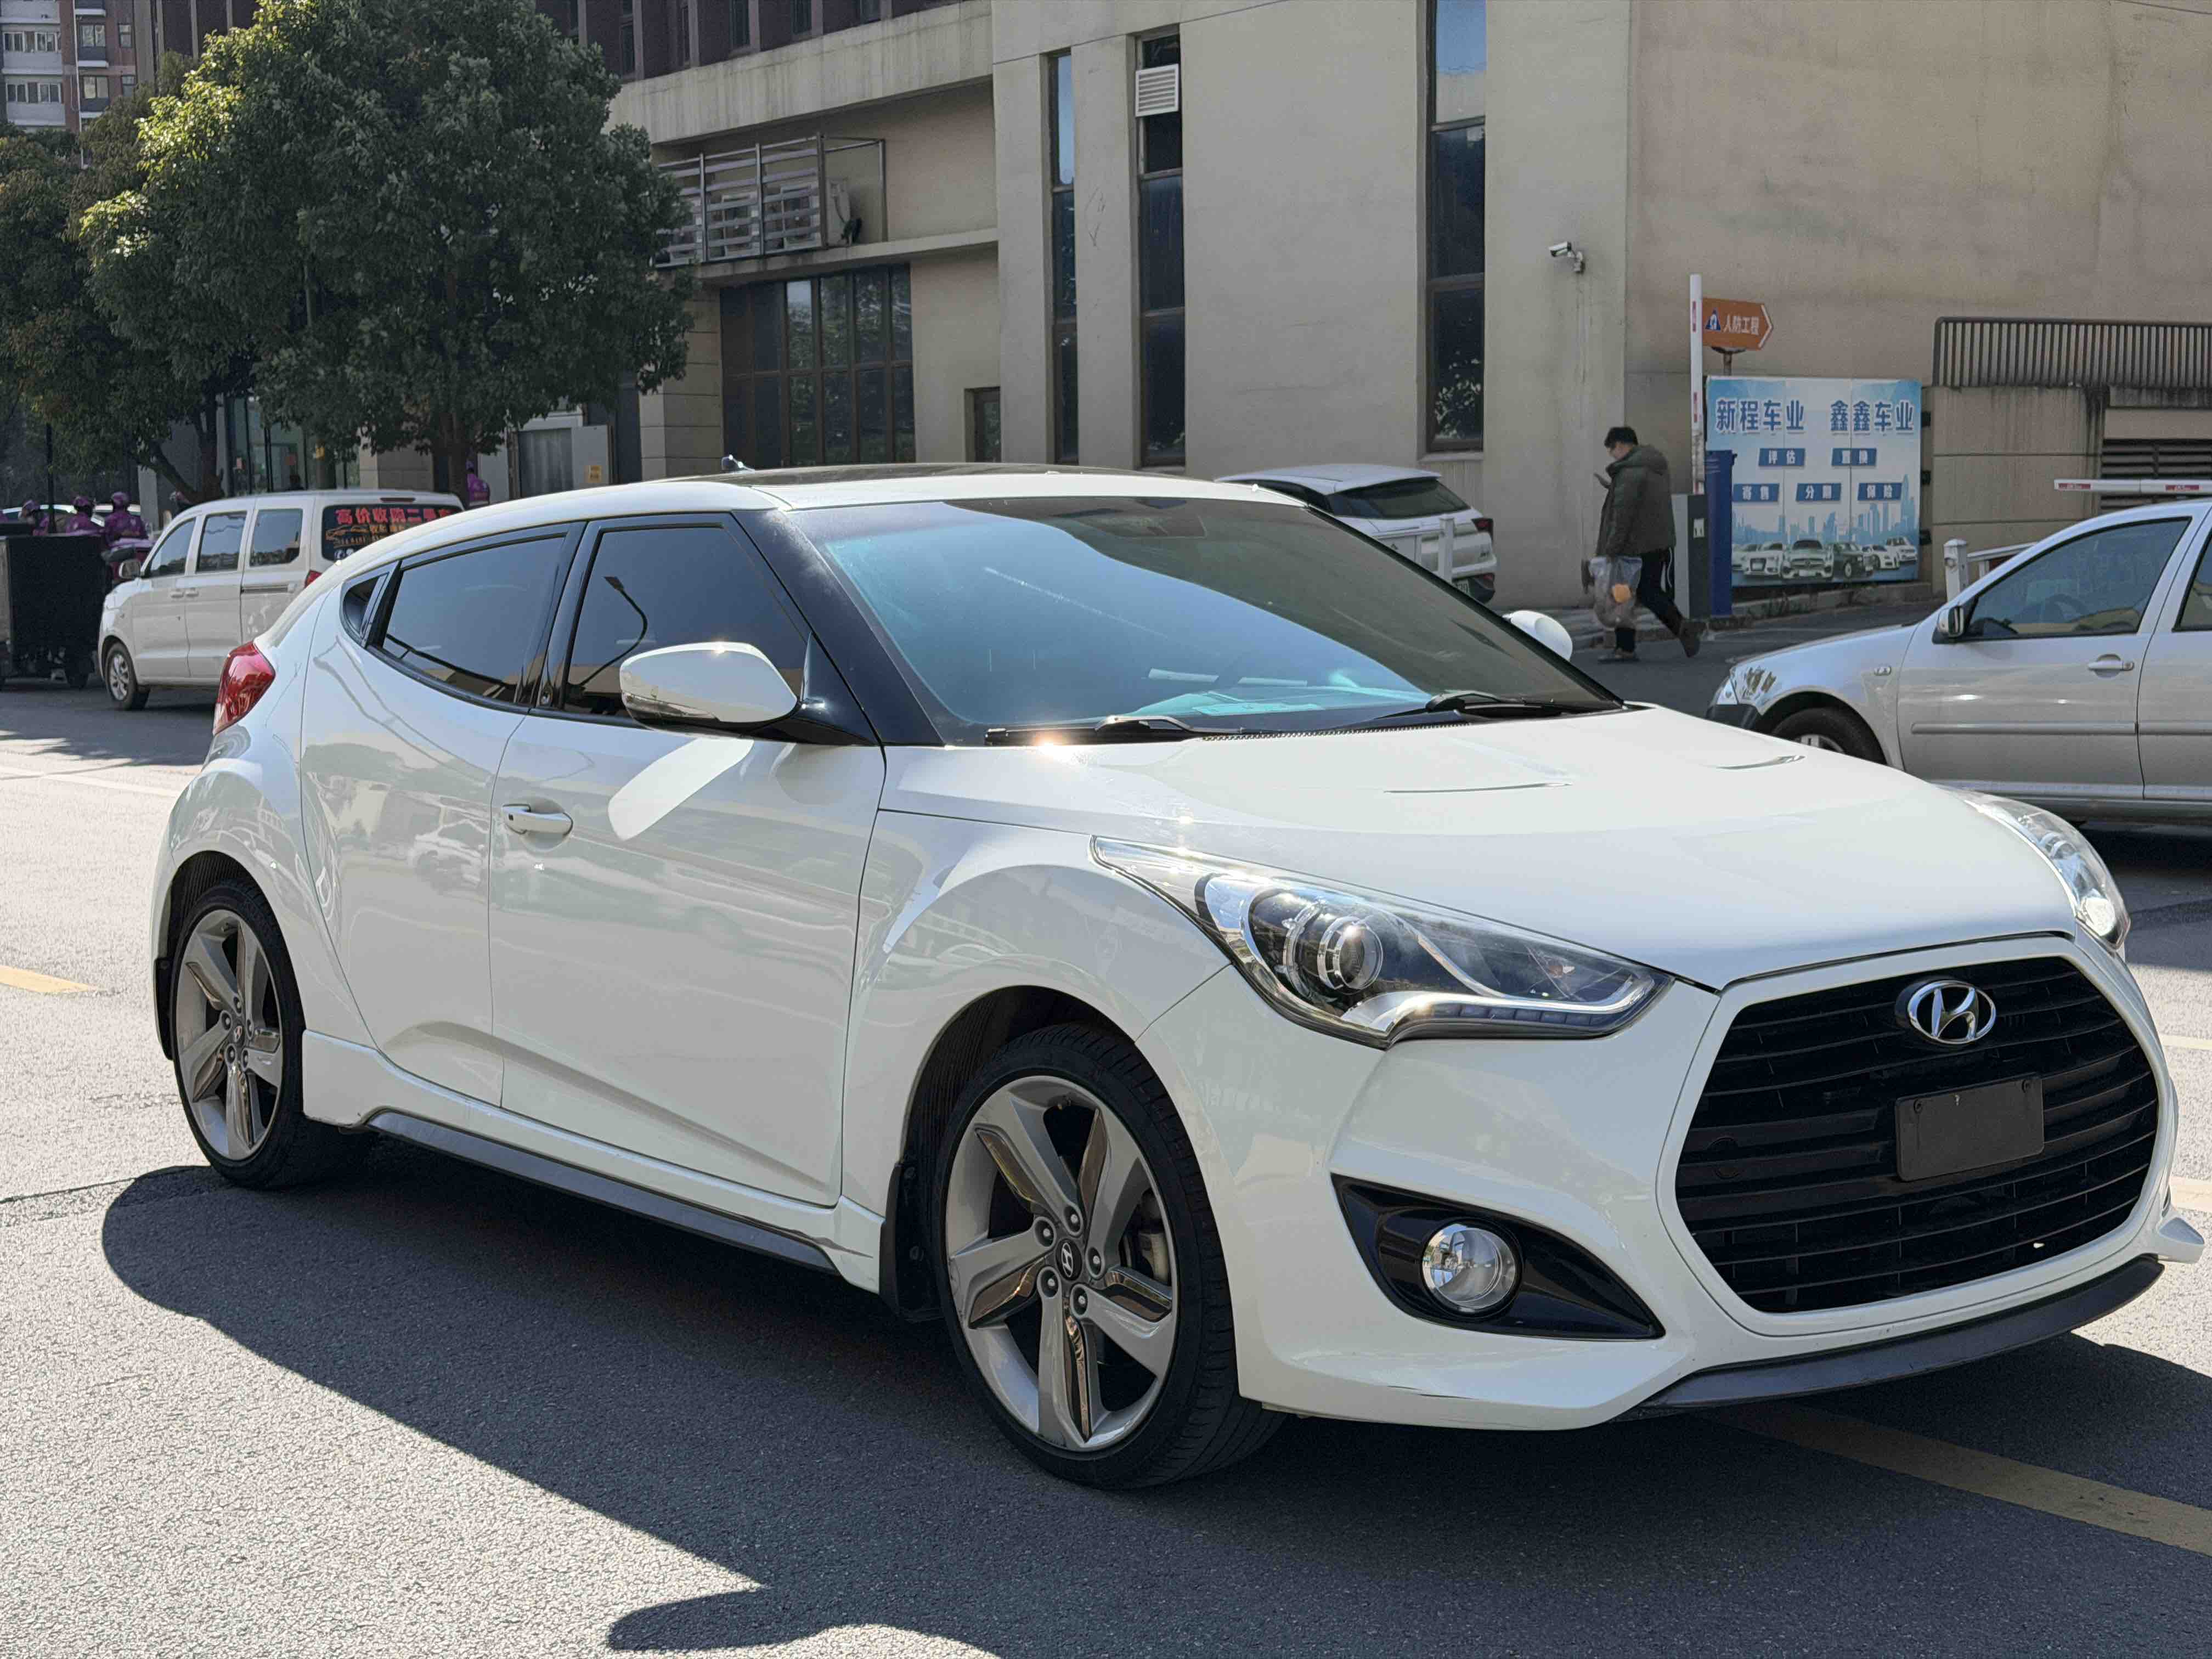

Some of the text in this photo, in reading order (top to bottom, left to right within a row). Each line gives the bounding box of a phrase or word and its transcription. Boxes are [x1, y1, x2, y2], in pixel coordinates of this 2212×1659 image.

[1716, 399, 1915, 433] 新程车业 鑫鑫车业
